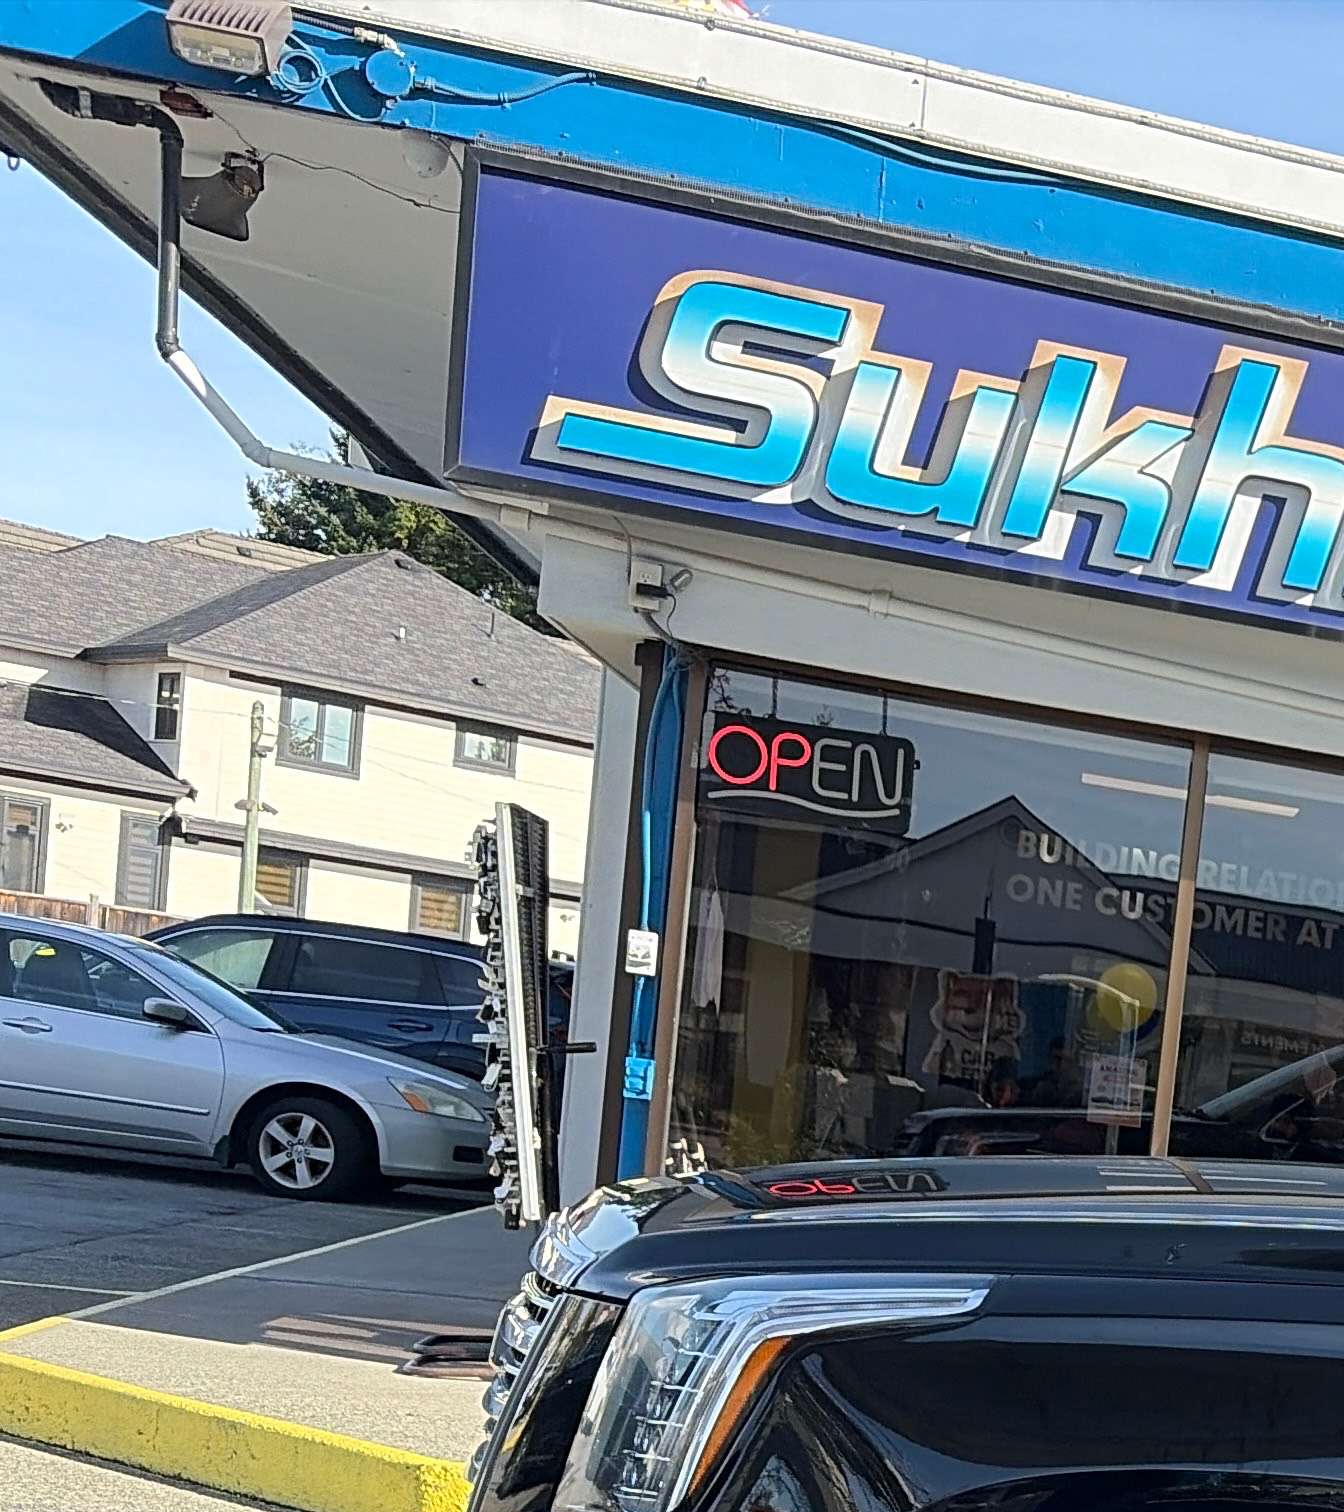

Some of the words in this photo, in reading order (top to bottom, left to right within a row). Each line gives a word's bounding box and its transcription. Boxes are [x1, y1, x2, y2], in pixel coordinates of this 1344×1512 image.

[708, 724, 905, 806] OPEN
[1016, 828, 1181, 882] BUILDING
[1006, 873, 1084, 911] ONE
[1296, 918, 1342, 950] AT
